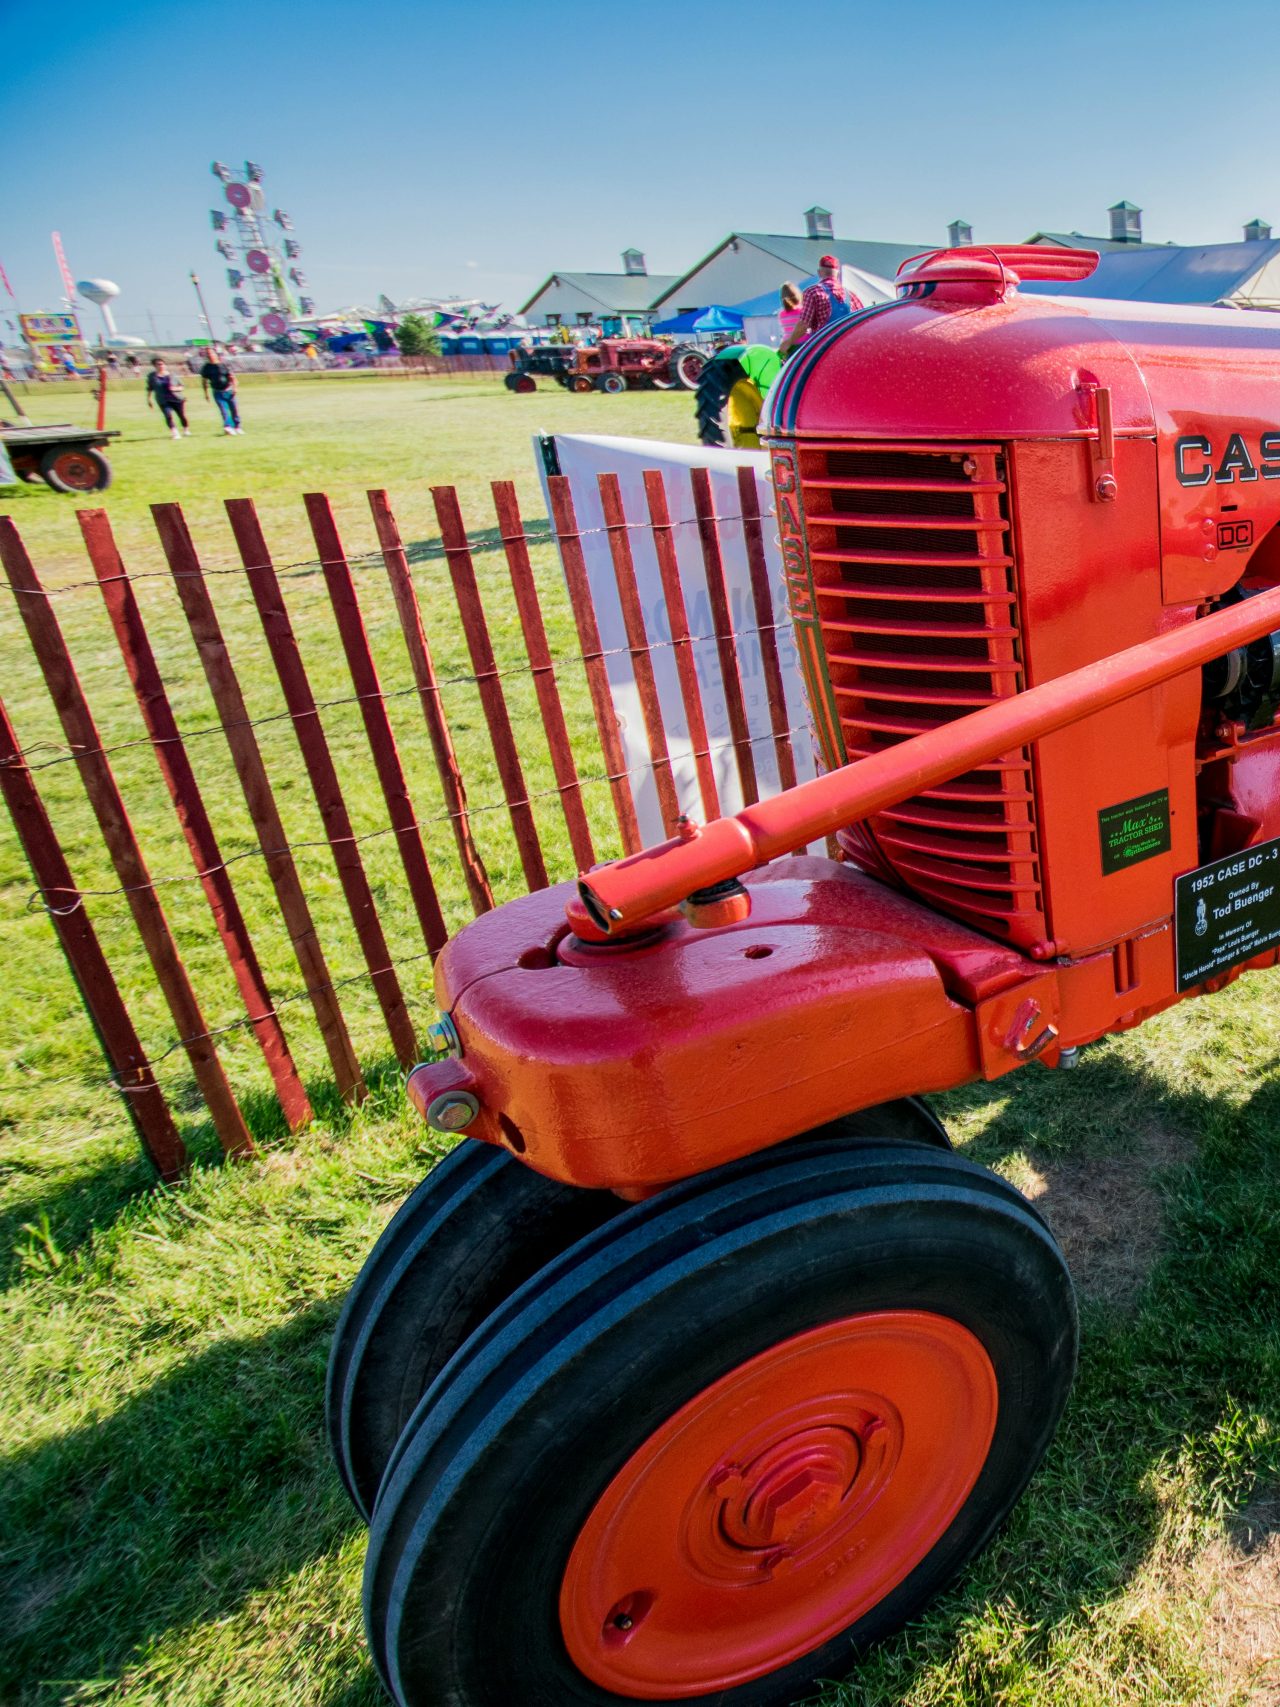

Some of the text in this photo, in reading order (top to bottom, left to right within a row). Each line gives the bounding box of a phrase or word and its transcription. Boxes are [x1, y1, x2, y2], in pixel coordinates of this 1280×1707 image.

[772, 455, 811, 613] CASE
[1219, 524, 1248, 546] DC
[1108, 822, 1164, 848] TRACTOR SHED
[1191, 874, 1214, 893] 1952
[1217, 861, 1246, 881] CASE
[1248, 854, 1263, 869] DC
[1272, 848, 1279, 859] 3
[1213, 886, 1274, 920] Tod Buenger
[1228, 881, 1260, 900] Owned By
[1225, 925, 1245, 938] Memory
